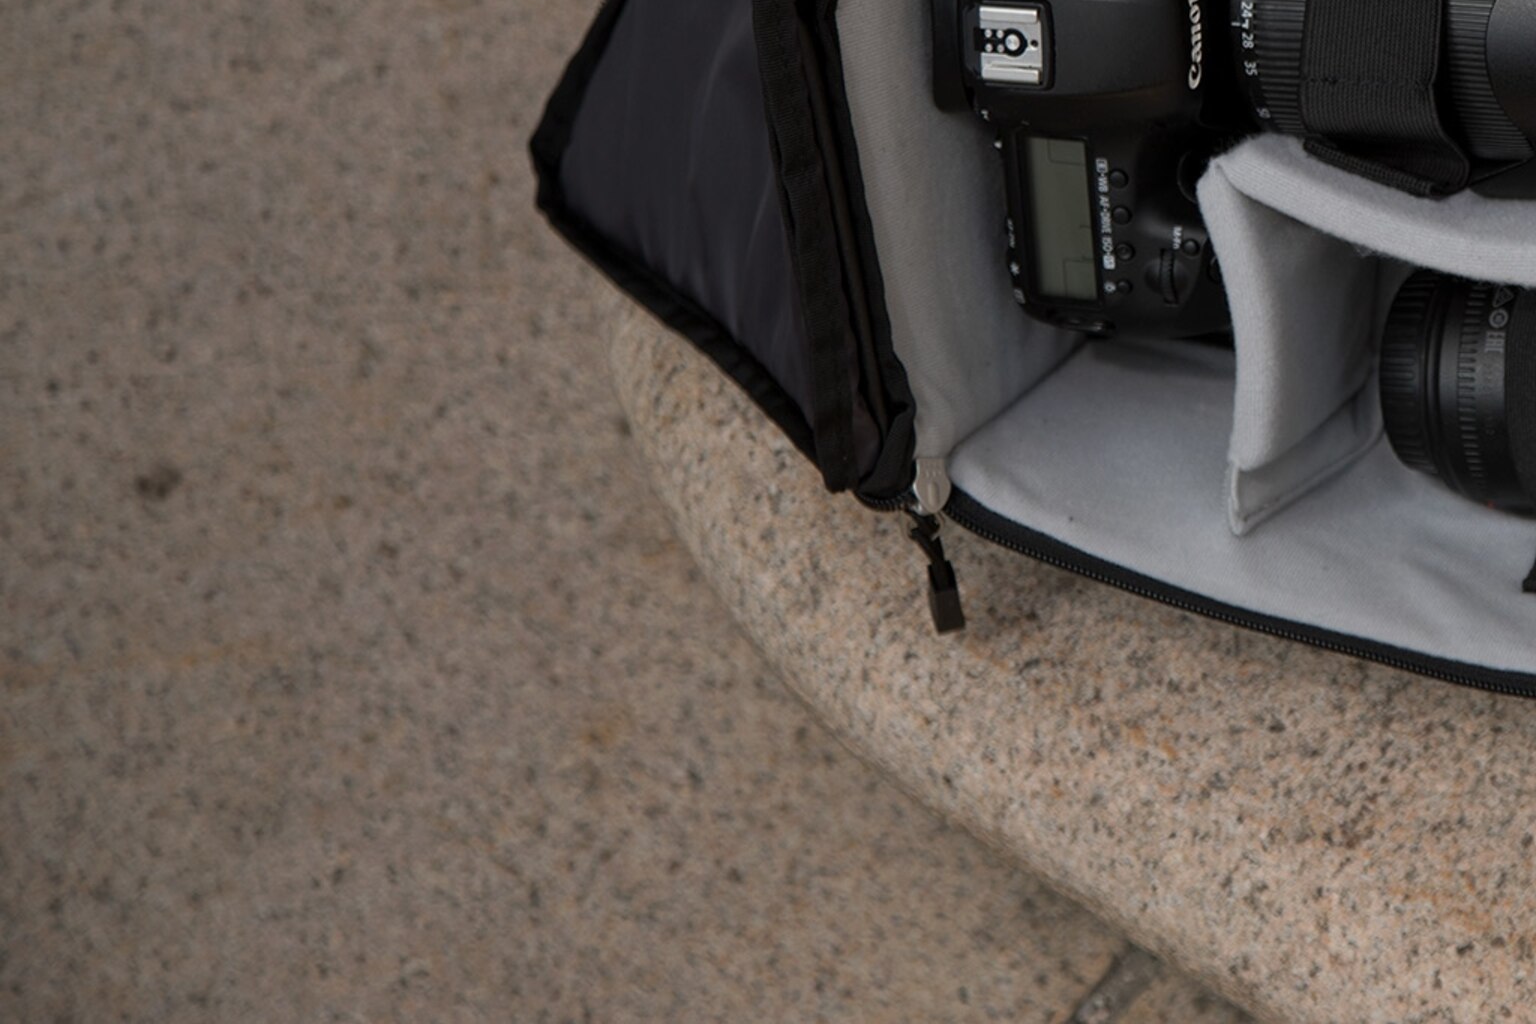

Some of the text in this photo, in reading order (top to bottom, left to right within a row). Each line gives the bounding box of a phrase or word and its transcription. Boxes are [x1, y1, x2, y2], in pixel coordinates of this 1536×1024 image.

[1240, 0, 1254, 18] 24
[1241, 31, 1254, 49] 28
[1243, 60, 1258, 77] 35
